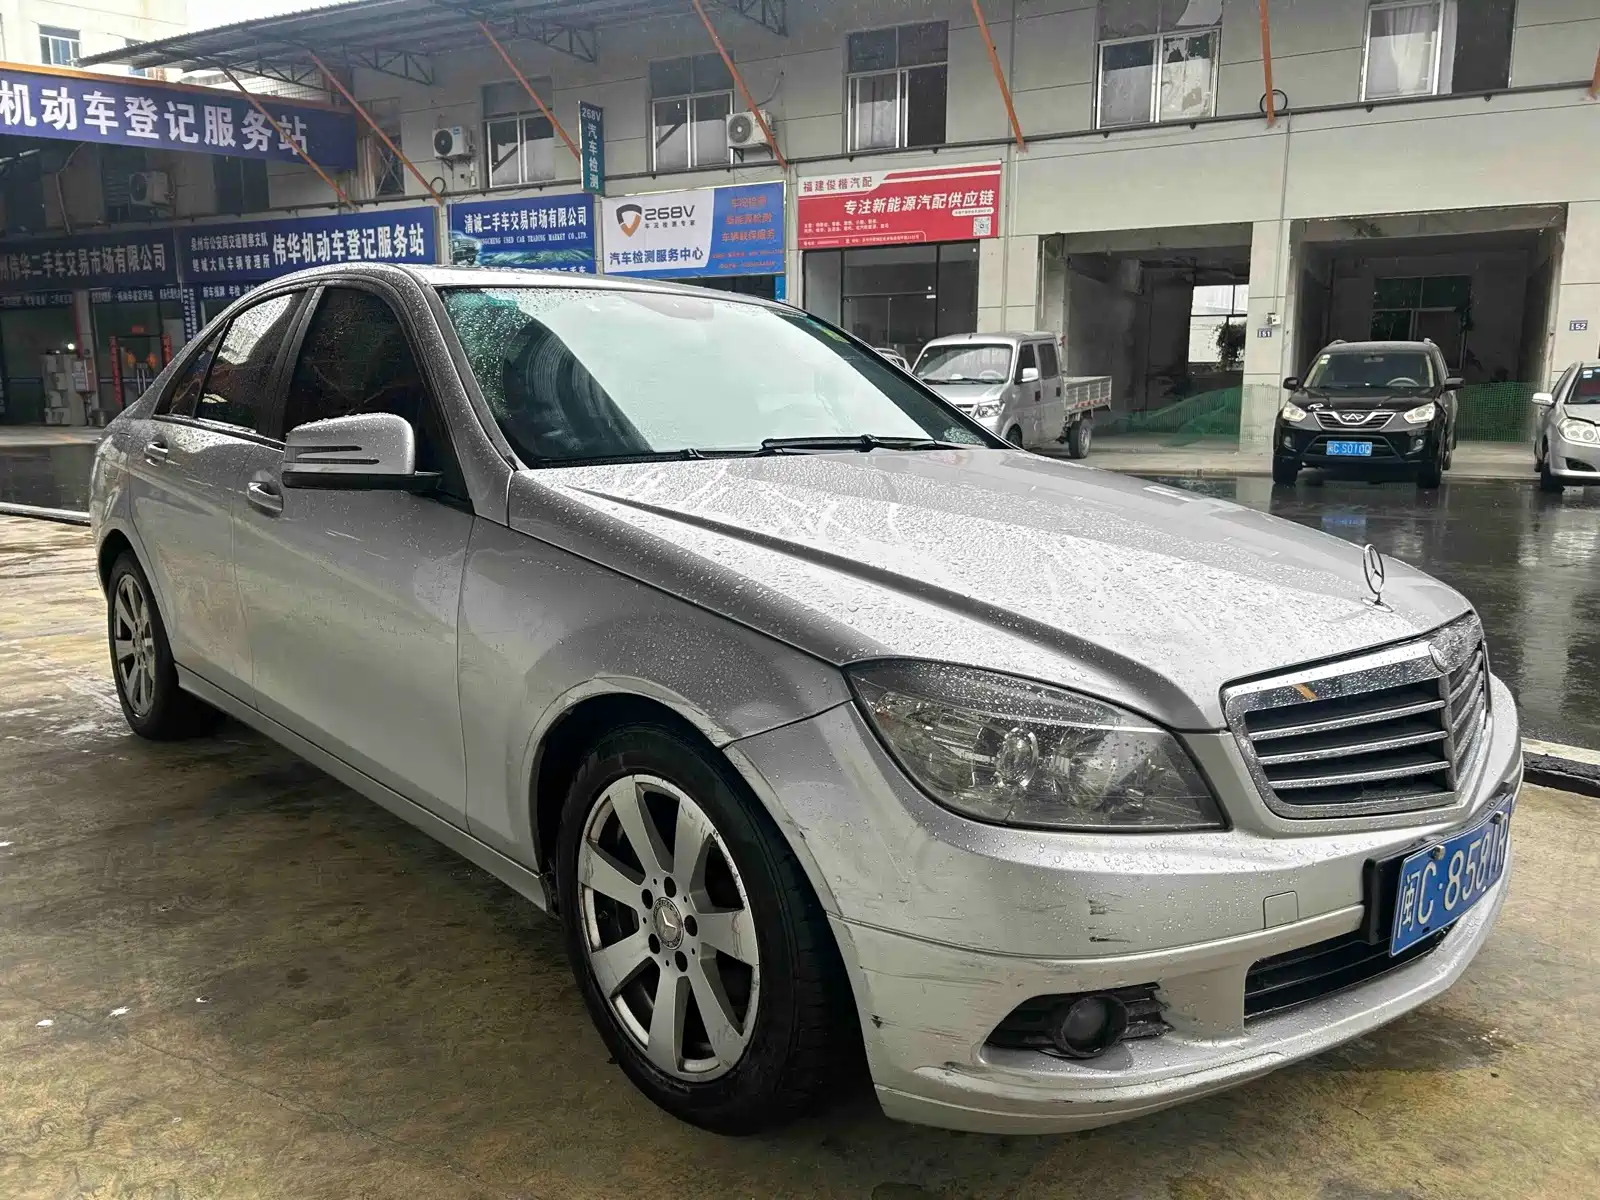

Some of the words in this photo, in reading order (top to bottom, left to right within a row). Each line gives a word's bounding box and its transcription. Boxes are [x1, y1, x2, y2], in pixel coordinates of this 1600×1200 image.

[0, 79, 309, 155] 机动车登记服务站
[582, 107, 601, 121] 268V
[587, 123, 599, 190] 汽车检测
[844, 189, 995, 215] 专注新能源汽配供应链
[645, 205, 695, 221] 268V
[645, 219, 695, 229] 车况检测专家
[272, 222, 424, 265] 伟华机动车登记服务站
[503, 236, 514, 244] USED
[516, 235, 526, 243] CAR
[609, 247, 704, 266] 汽车检测服务中心
